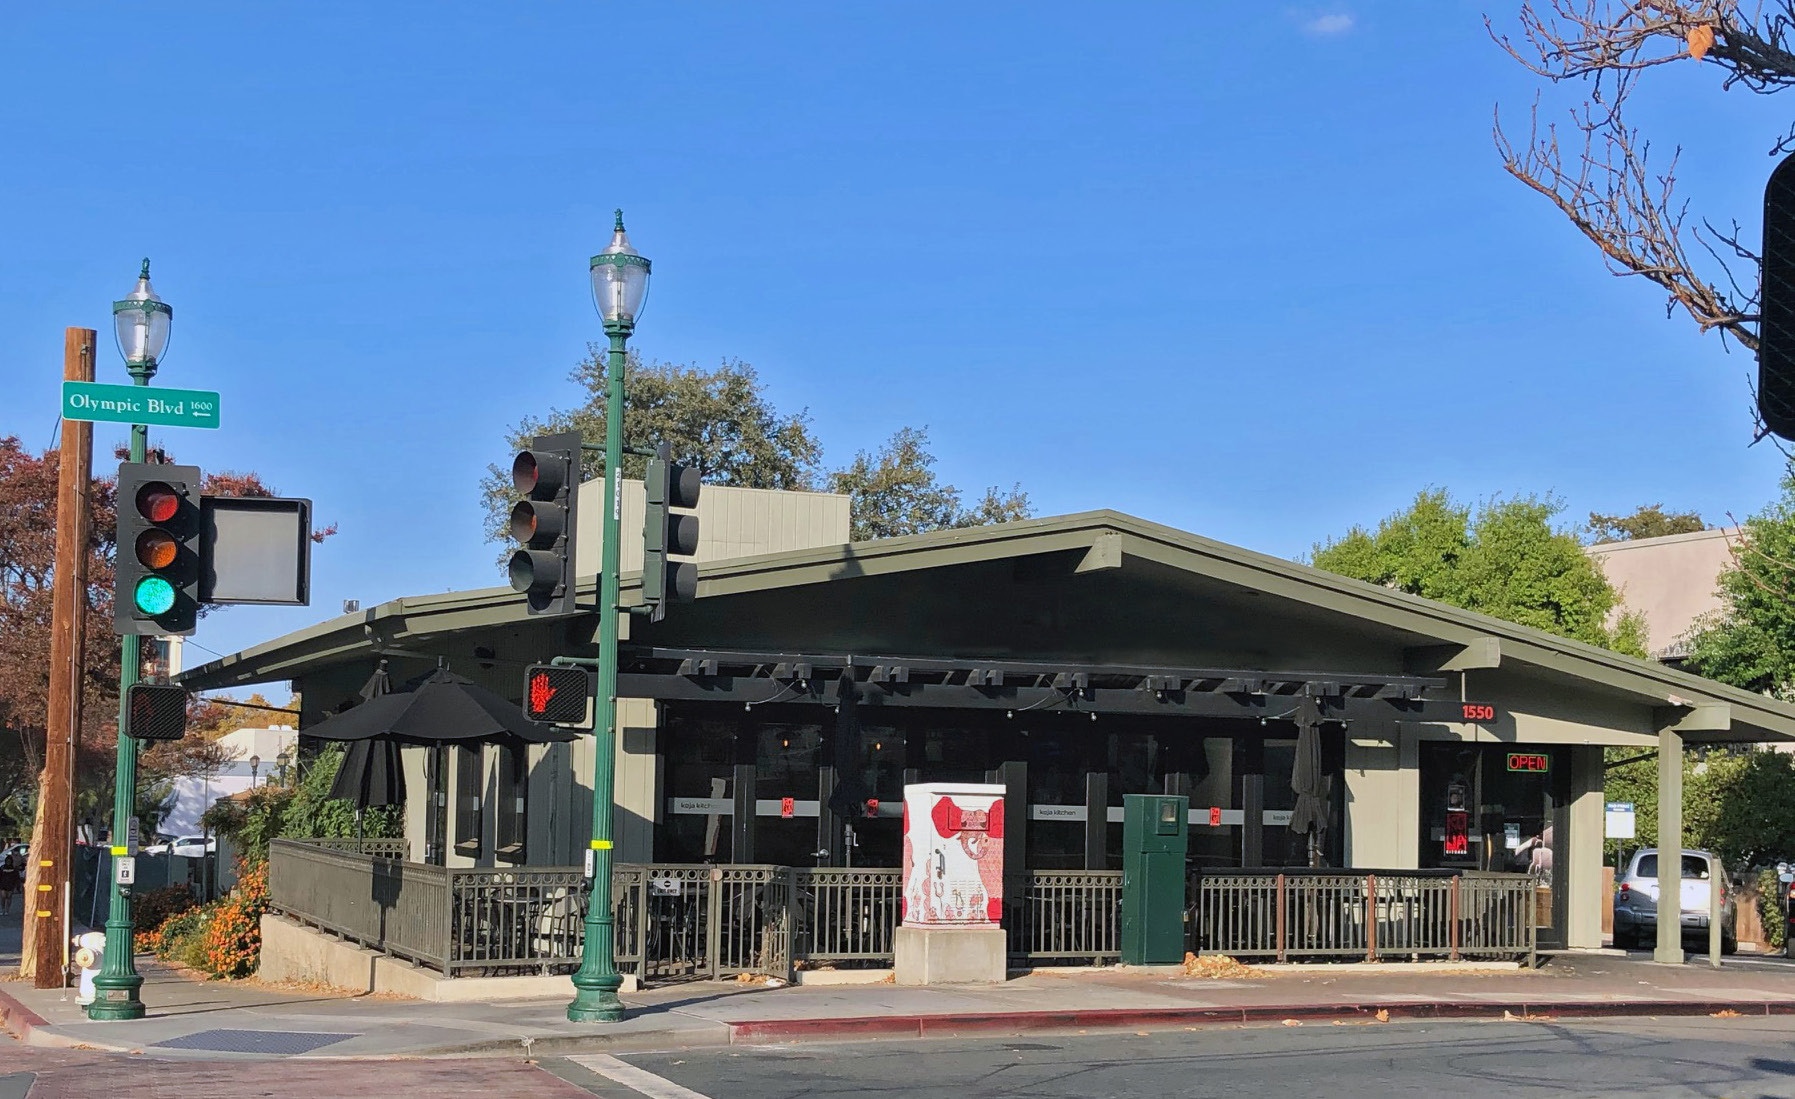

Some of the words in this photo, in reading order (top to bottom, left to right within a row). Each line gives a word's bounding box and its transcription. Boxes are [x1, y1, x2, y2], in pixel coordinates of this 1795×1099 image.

[70, 394, 141, 414] Olympic
[147, 398, 184, 415] Blvd
[191, 401, 213, 411] 1600
[1462, 705, 1494, 720] 1550
[1509, 755, 1547, 771] OPEN
